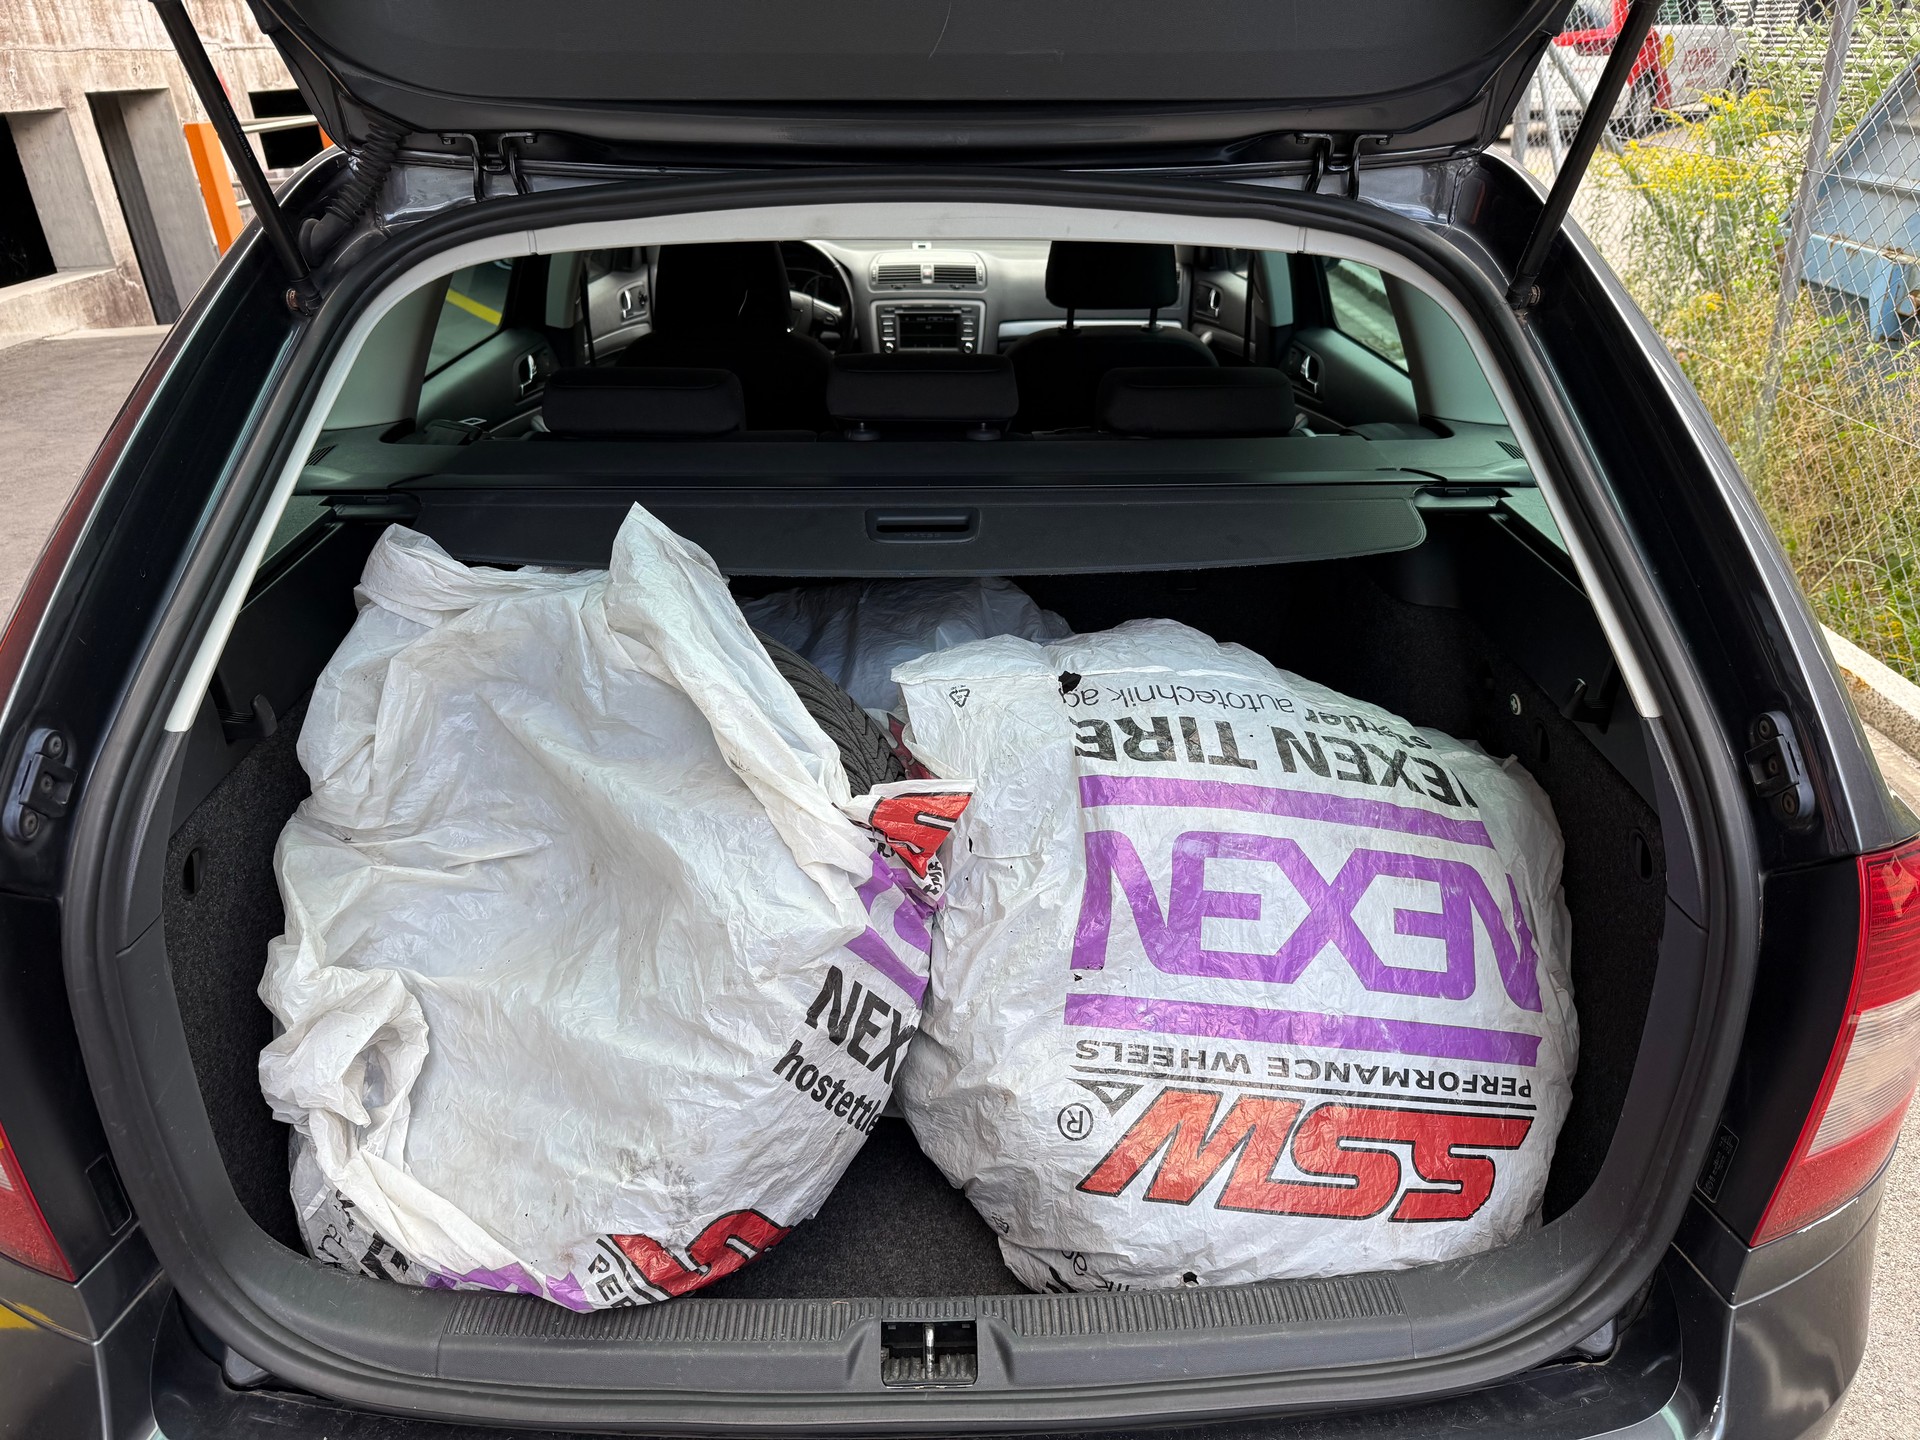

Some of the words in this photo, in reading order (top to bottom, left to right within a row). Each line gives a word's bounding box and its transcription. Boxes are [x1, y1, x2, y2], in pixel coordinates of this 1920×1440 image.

[1105, 683, 1295, 714] autotechnik
[1069, 715, 1258, 770] TIRE
[1070, 829, 1543, 1013] NEXEN
[1075, 1038, 1252, 1075] WHEELS
[1266, 1058, 1533, 1098] PERFORMANCE
[1076, 1085, 1535, 1224] SSW
